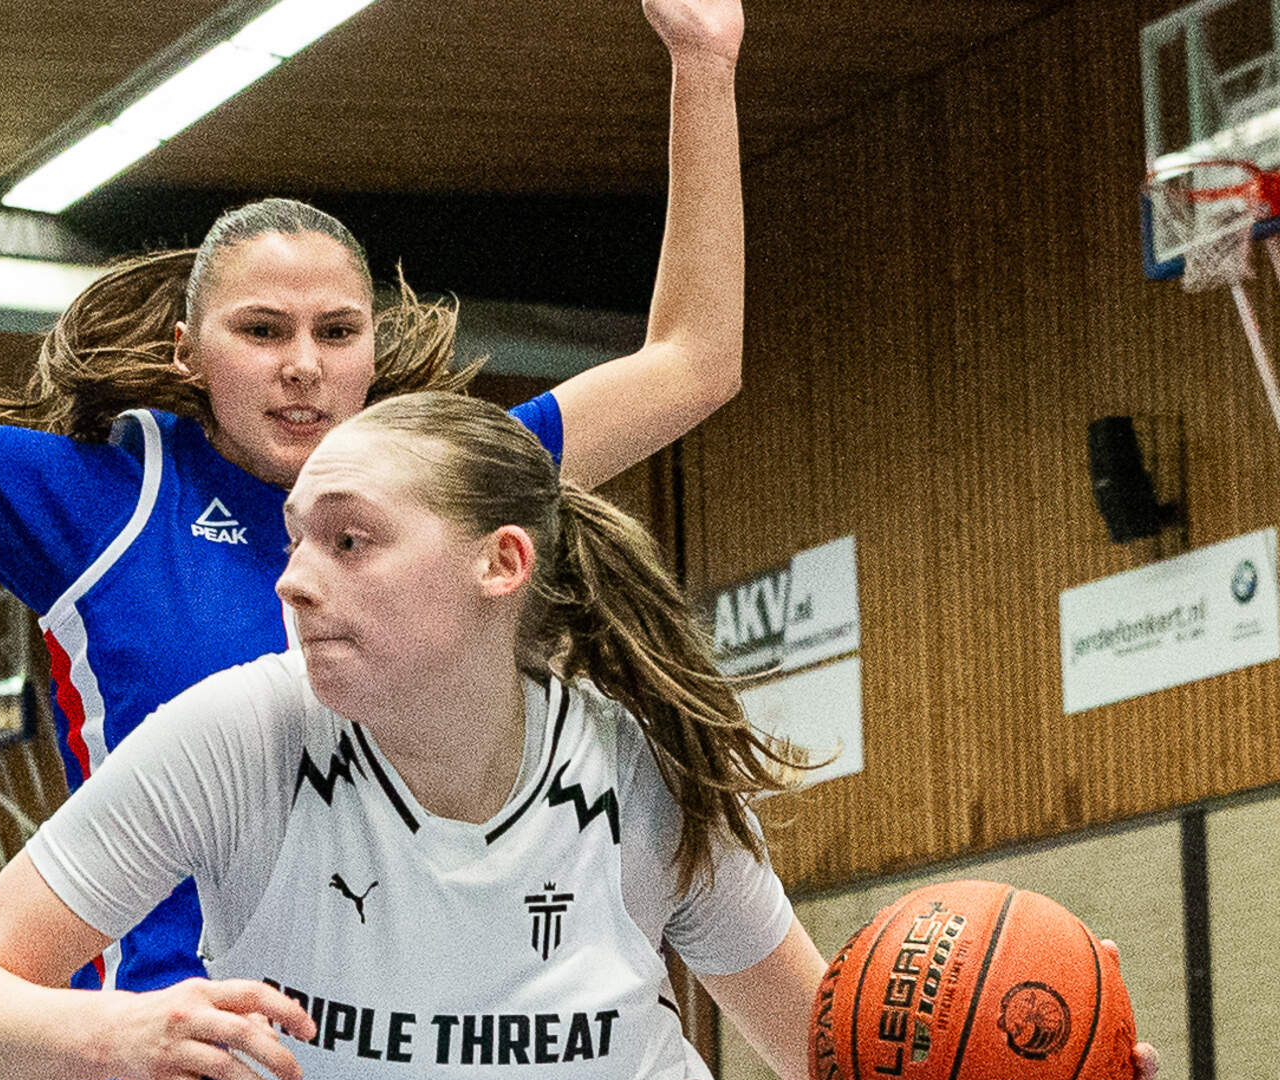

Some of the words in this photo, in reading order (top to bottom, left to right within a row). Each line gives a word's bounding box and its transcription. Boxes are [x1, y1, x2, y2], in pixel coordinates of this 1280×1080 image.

[190, 524, 248, 545] PEAK
[263, 976, 417, 1064] IPLE
[429, 1008, 620, 1066] THREAT
[874, 901, 949, 1077] LEGACY
